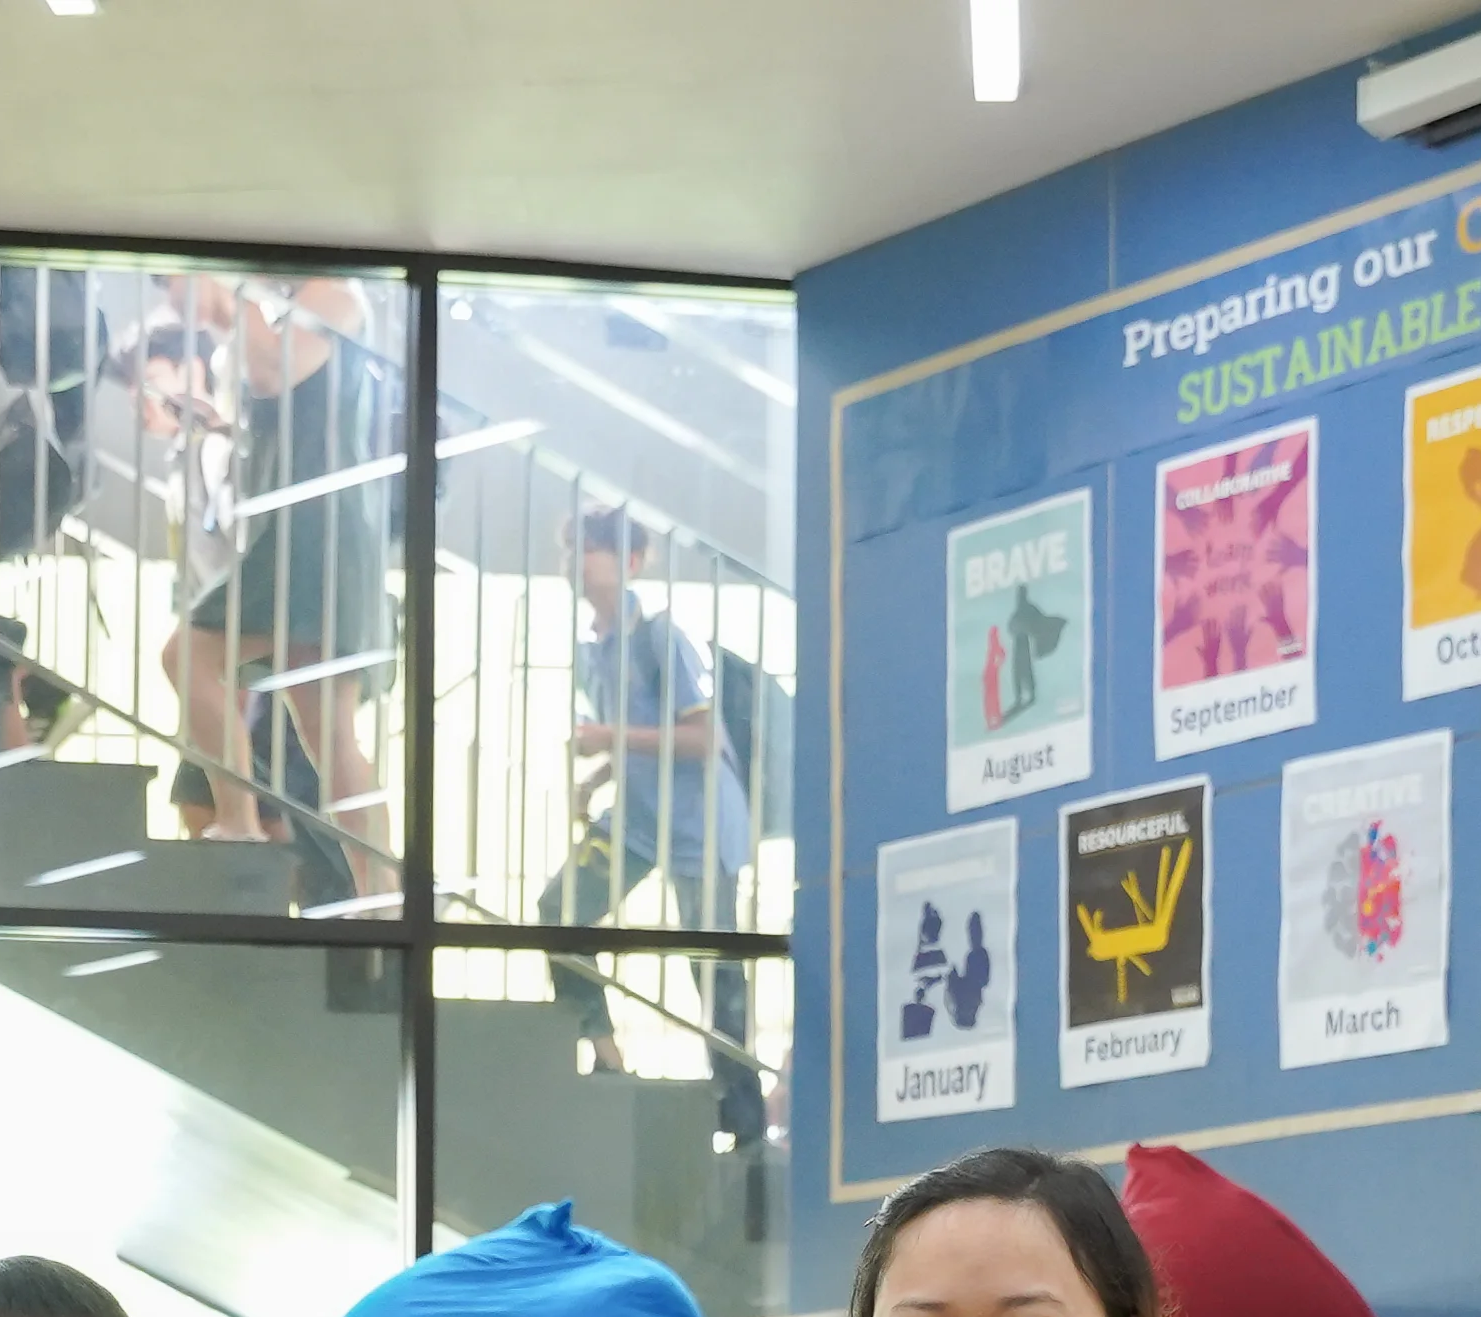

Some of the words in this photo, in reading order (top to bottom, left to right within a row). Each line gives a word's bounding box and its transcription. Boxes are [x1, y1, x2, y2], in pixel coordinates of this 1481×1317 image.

[1123, 262, 1339, 367] Preparing
[1354, 229, 1437, 288] our
[965, 531, 1069, 599] BRAVE
[1171, 683, 1298, 737] September
[982, 744, 1055, 785] August
[1303, 773, 1424, 823] CREATIVE
[1077, 811, 1190, 855] RESOURCEFUL
[1323, 1001, 1401, 1038] March
[1084, 1026, 1183, 1064] February
[895, 1062, 990, 1103] January
